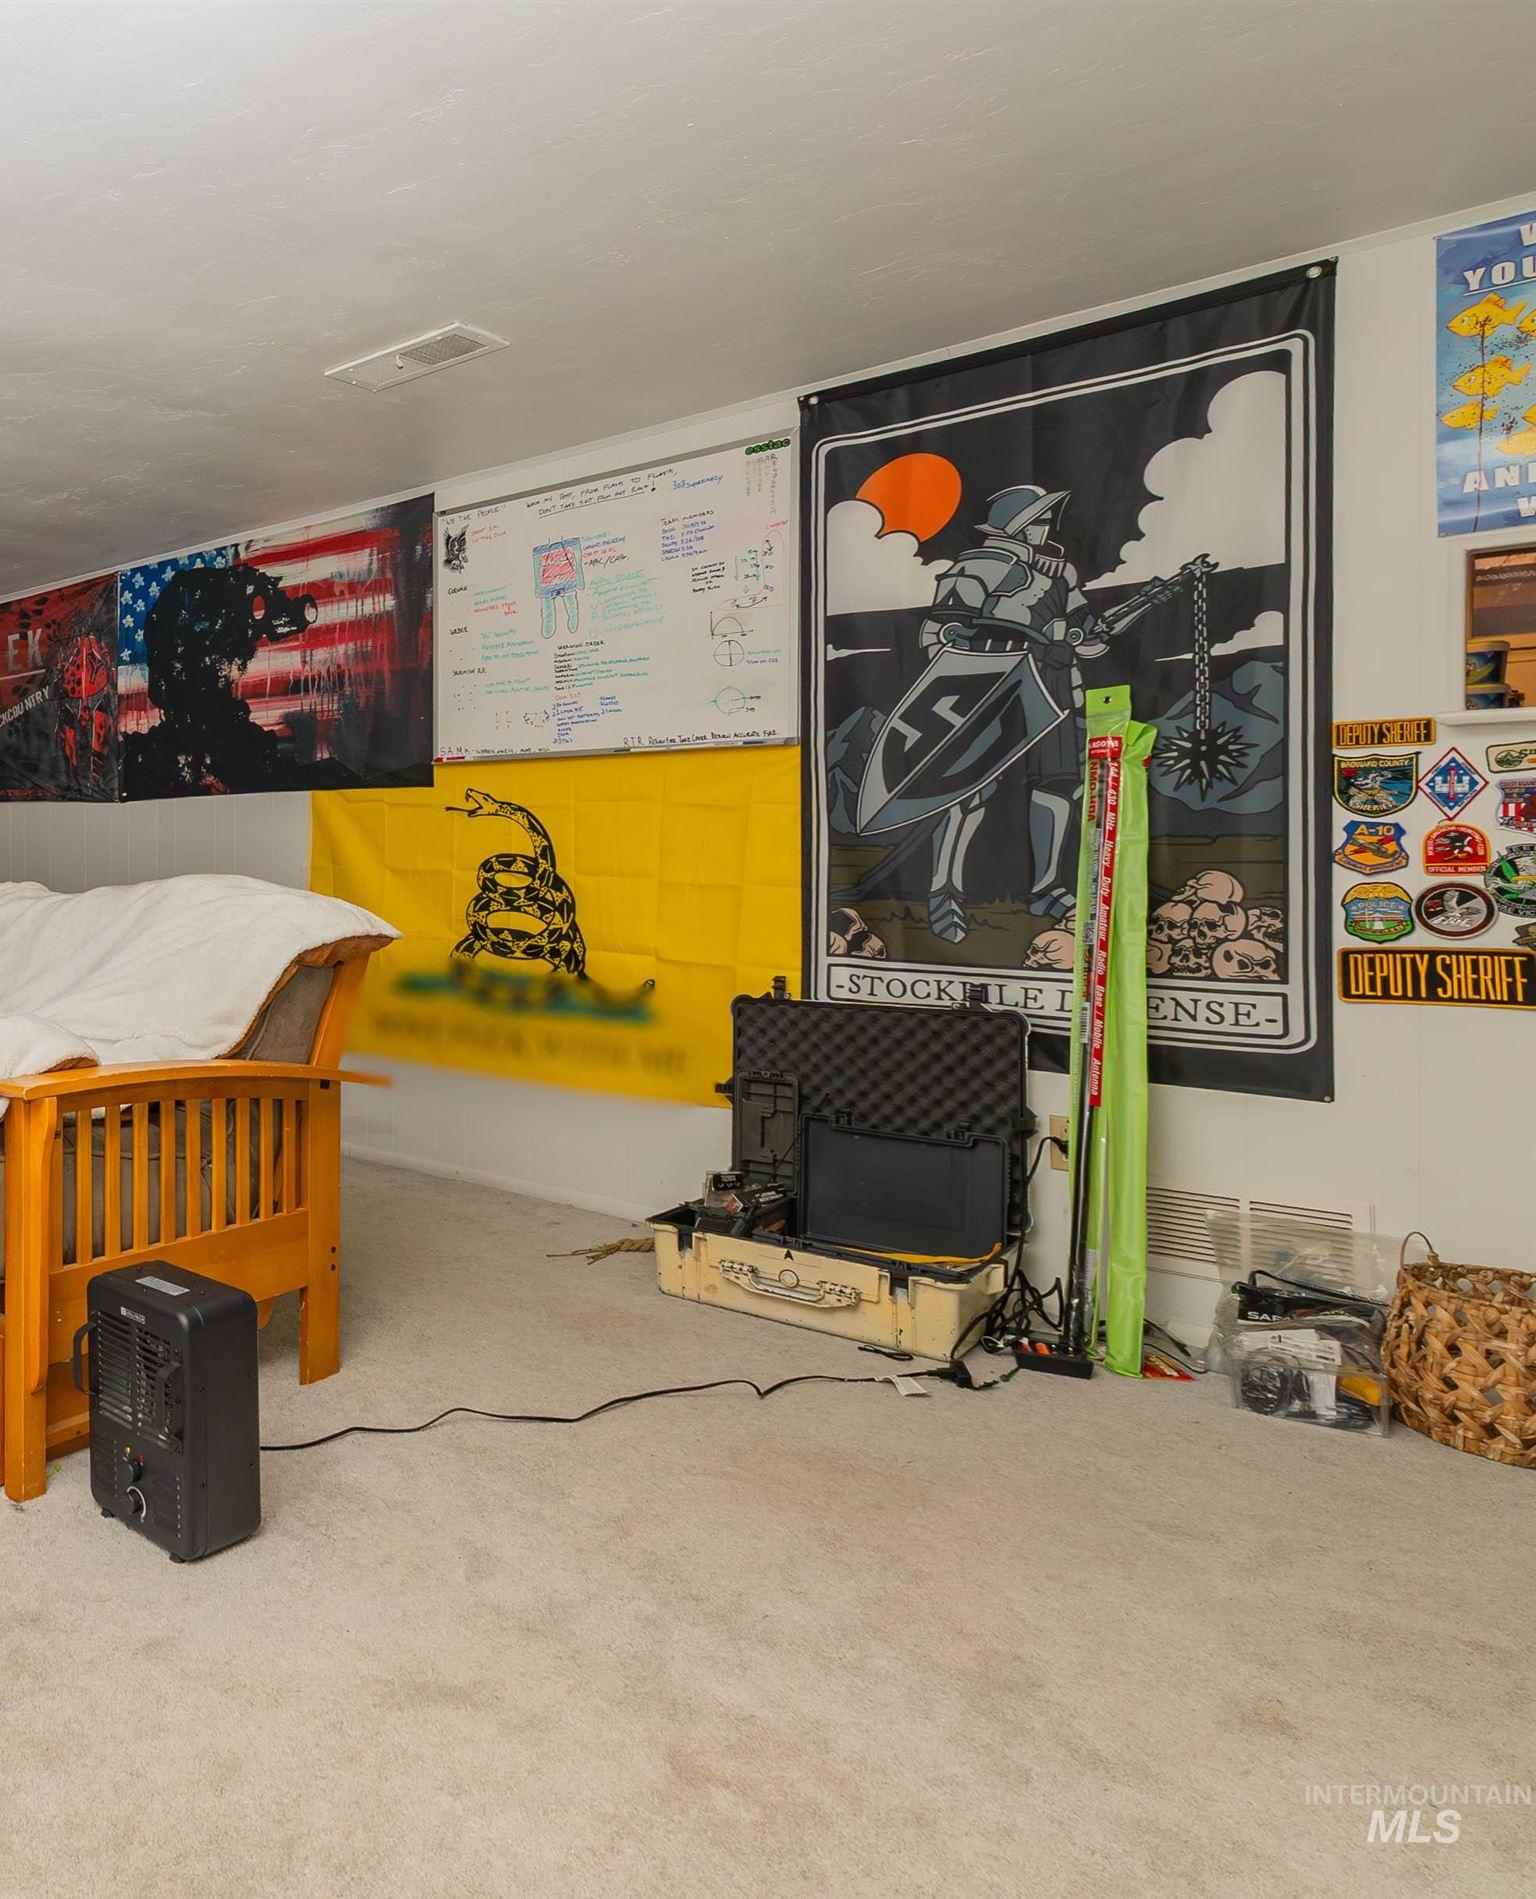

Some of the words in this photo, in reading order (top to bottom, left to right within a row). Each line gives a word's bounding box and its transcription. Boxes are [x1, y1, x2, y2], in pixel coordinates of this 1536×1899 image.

[1339, 722, 1380, 746] DEPUTY
[1382, 720, 1428, 745] SHERIFF
[1378, 758, 1410, 768] COUNTY
[1107, 788, 1117, 806] 430
[1353, 800, 1394, 812] SHERIFF
[1105, 811, 1116, 830] MHz
[1353, 823, 1396, 836] A-10
[1102, 839, 1114, 867] Heavy
[1427, 865, 1456, 874] OFFICIAL
[1457, 865, 1486, 873] MEMBER
[1100, 876, 1111, 897] Duty
[1098, 905, 1110, 941] Amateur
[1097, 950, 1107, 976] Radio
[1349, 953, 1429, 998] DEPUTY
[1436, 955, 1528, 1002] SHERIFF
[1095, 985, 1105, 1008] Base
[1092, 1020, 1104, 1049] Mobile
[1090, 1057, 1101, 1096] Antenna
